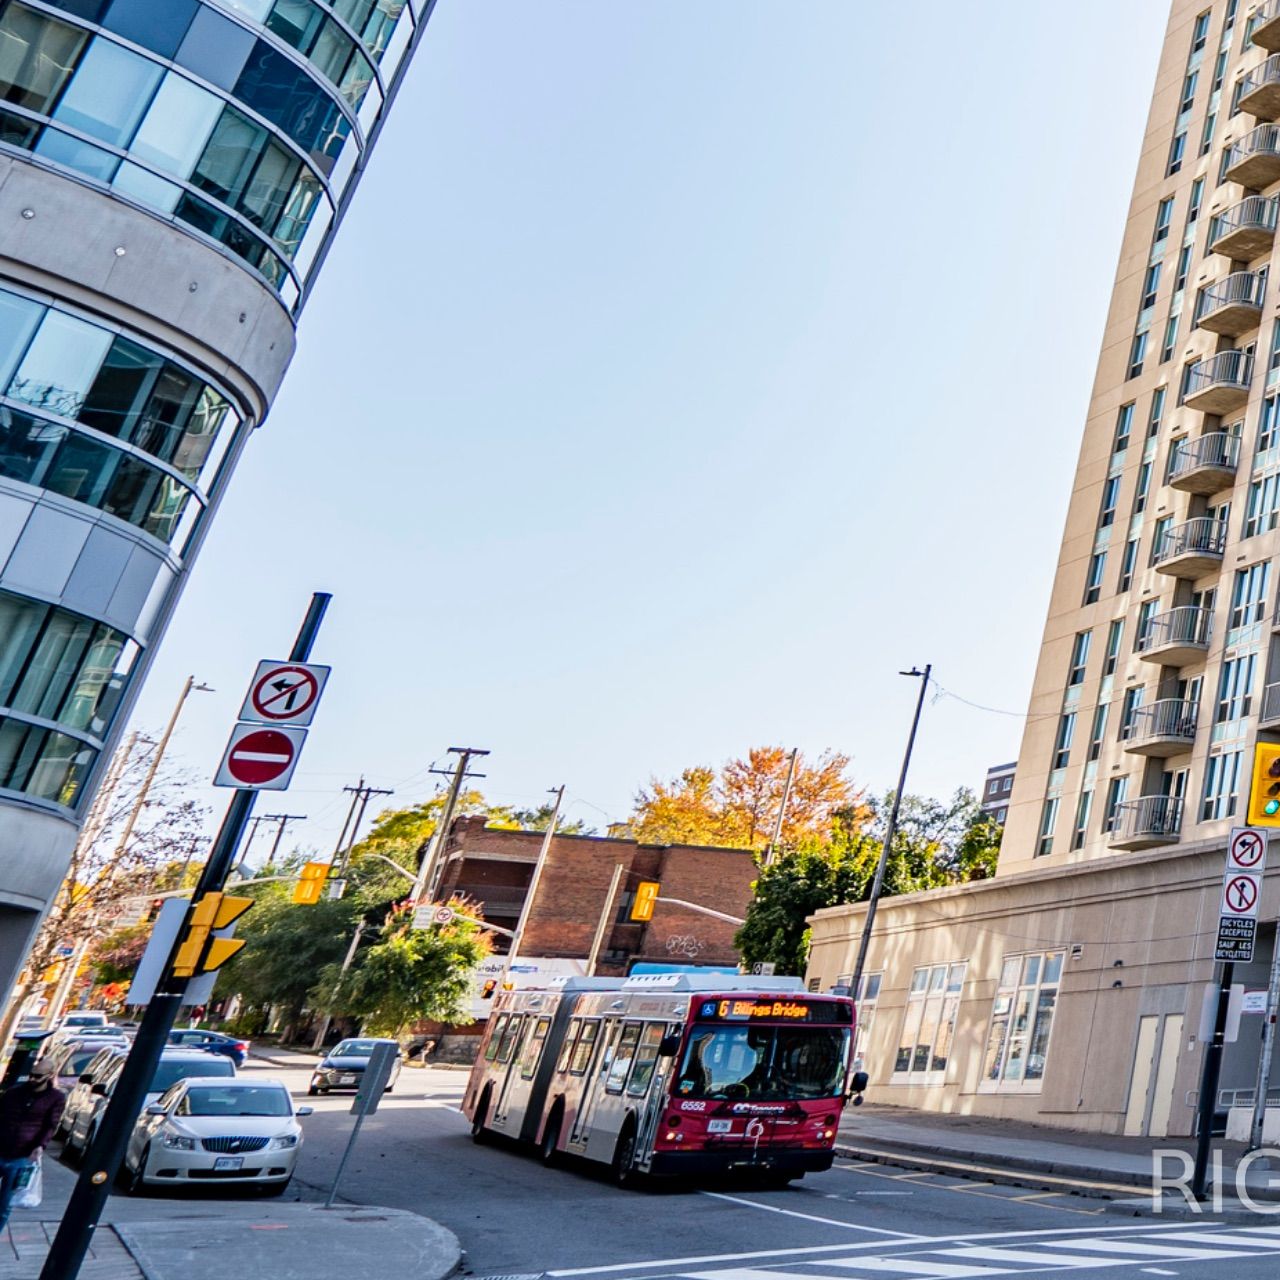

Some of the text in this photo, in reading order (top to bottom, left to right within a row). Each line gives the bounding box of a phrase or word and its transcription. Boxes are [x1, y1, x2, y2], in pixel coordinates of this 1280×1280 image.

[1221, 919, 1254, 929] BICYCLES
[1220, 928, 1253, 937] EXCEPTED
[1218, 940, 1252, 950] SAUF LES
[1216, 949, 1251, 959] BICYCLETTES
[718, 1000, 808, 1018] 6 Billings Bridge
[681, 1100, 706, 1111] 6552
